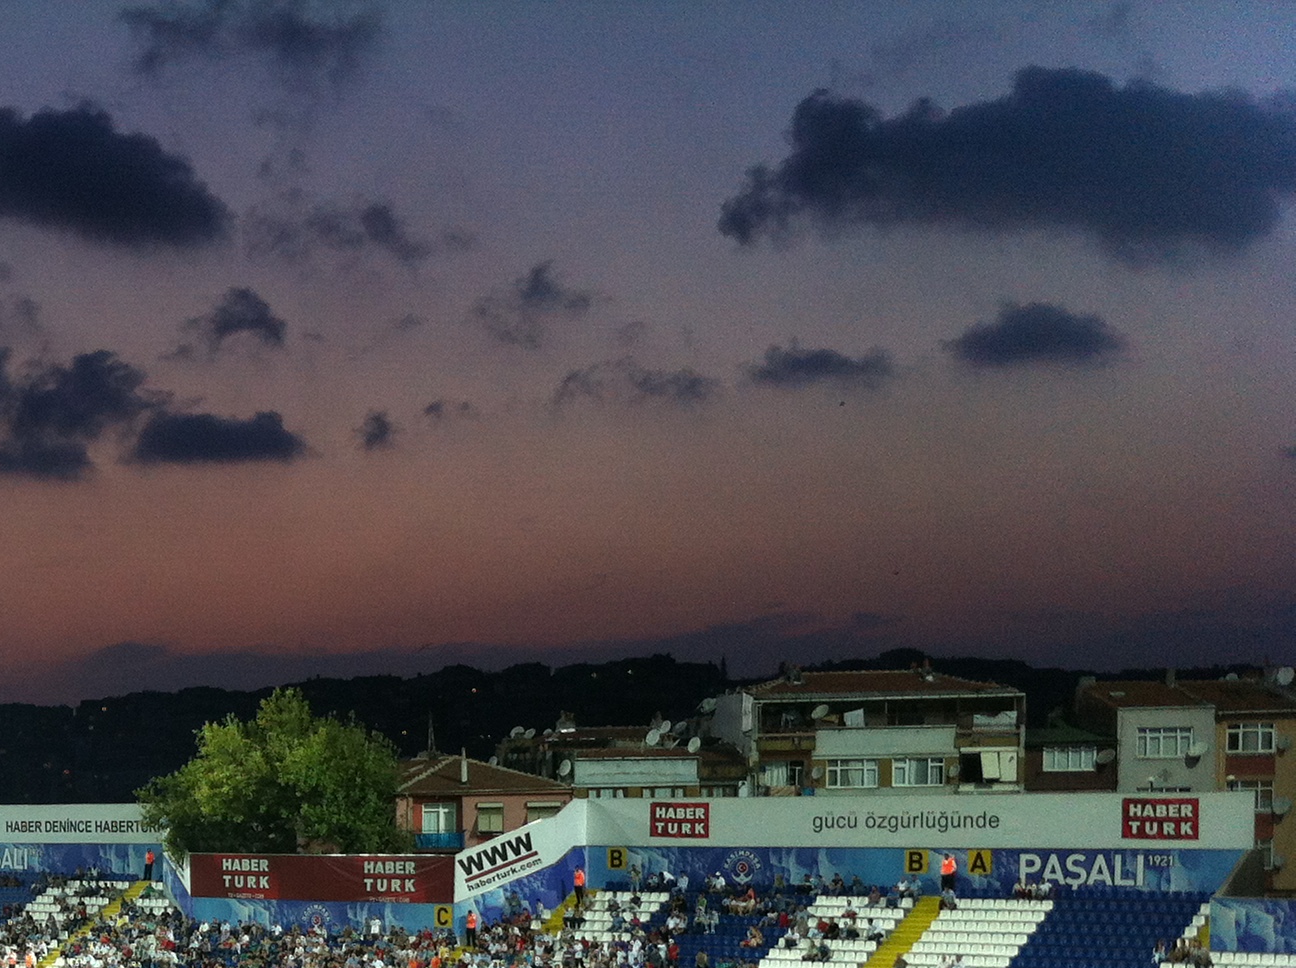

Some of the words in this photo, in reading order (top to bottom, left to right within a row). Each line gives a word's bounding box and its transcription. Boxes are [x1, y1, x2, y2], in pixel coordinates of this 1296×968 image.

[655, 807, 705, 820] HABER
[1129, 803, 1193, 818] HABER
[6, 820, 42, 833] HABER
[655, 822, 705, 835] TURK
[813, 810, 857, 834] gücü
[865, 810, 1000, 834] özgürlüğünde
[1129, 821, 1194, 835] TURK
[223, 858, 269, 871] HABER
[610, 851, 622, 868] B
[909, 852, 923, 871] B
[970, 851, 987, 872] A
[364, 861, 416, 874] HABER
[1019, 853, 1145, 891] PAŞALI
[1148, 855, 1173, 866] 1921
[223, 875, 270, 889] TURK
[364, 878, 416, 892] TURK
[437, 907, 448, 926] C
